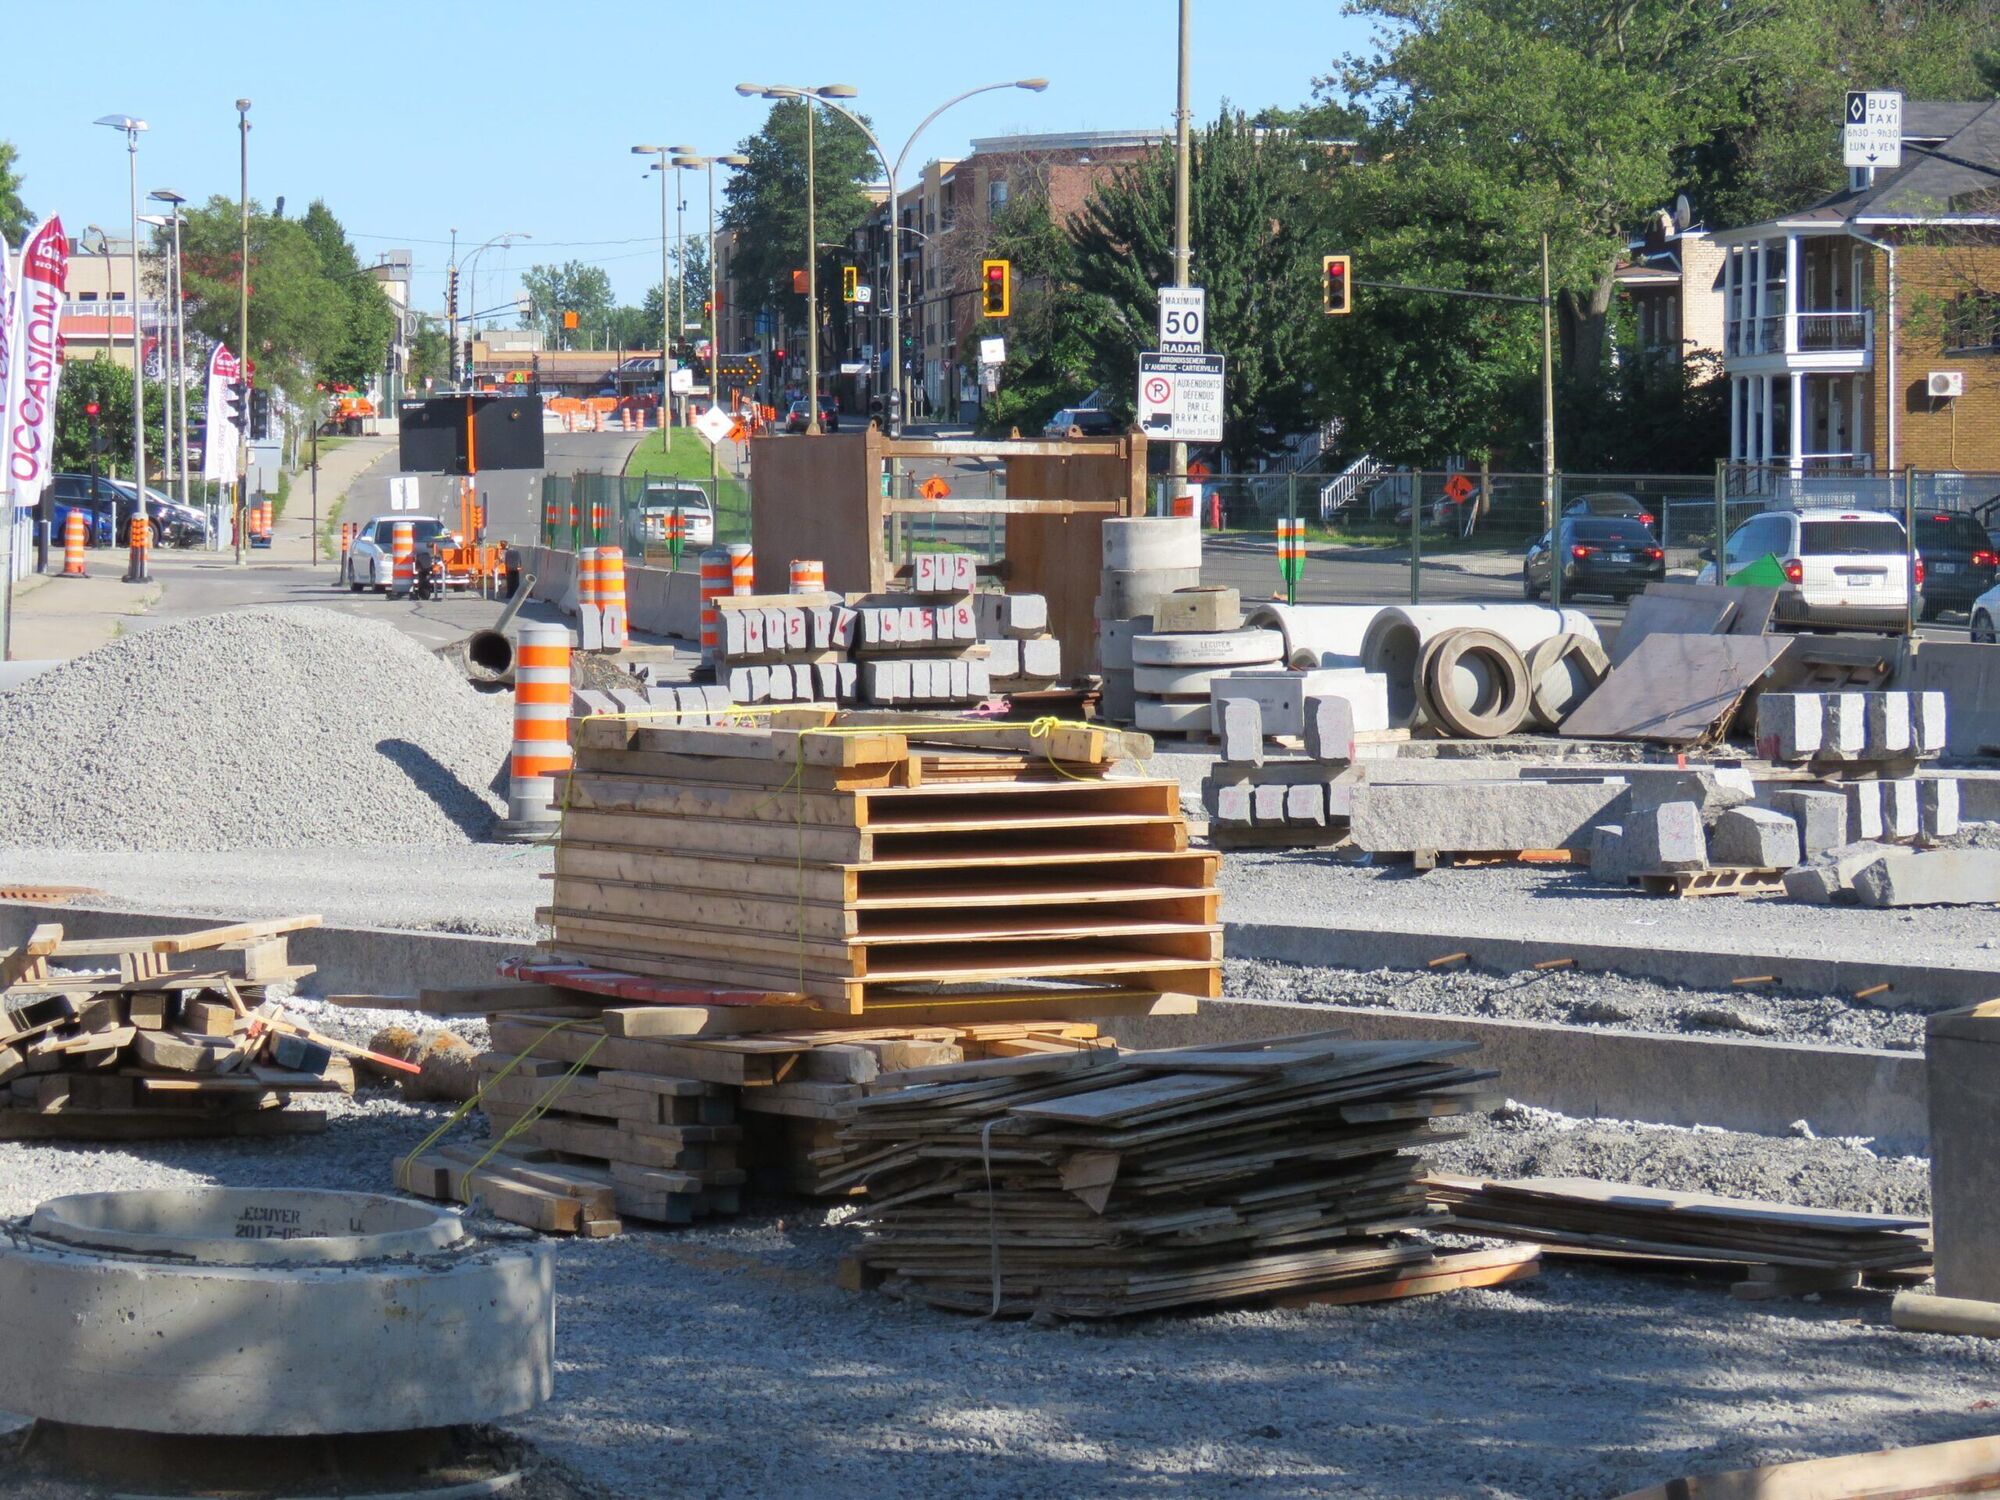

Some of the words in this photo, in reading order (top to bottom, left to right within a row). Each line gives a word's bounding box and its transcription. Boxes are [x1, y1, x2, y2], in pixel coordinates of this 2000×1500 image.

[1868, 99, 1897, 110] BUS
[1868, 114, 1897, 124] TAXI
[1848, 129, 1868, 137] 6h30
[1877, 129, 1898, 138] 9h30
[1849, 142, 1866, 151] LUN
[1878, 142, 1896, 151] VEN
[1165, 297, 1201, 305] MAXIMUM
[1165, 311, 1199, 335] 50
[1162, 343, 1201, 353] RADAR
[11, 290, 58, 482] OCCASION
[1187, 402, 1200, 412] PAR
[1201, 402, 1209, 411] LE
